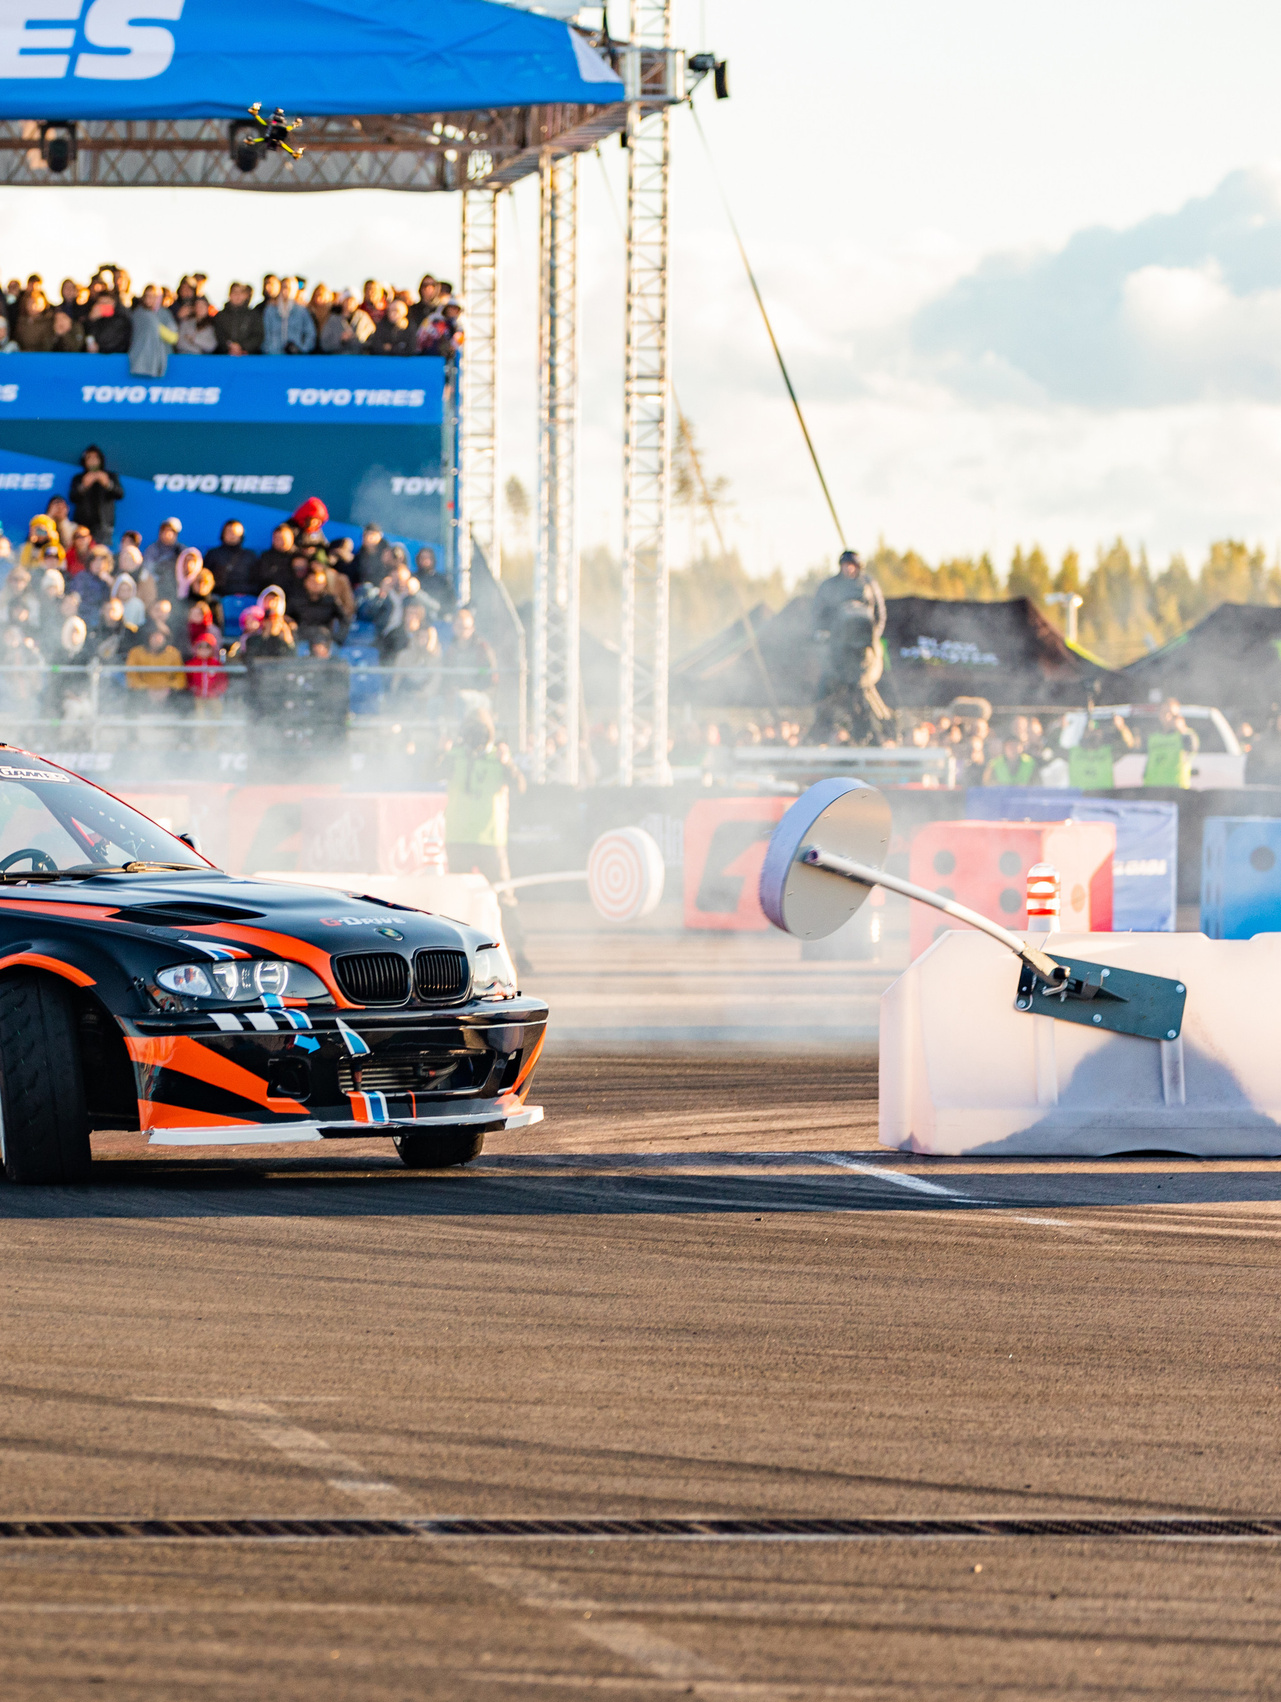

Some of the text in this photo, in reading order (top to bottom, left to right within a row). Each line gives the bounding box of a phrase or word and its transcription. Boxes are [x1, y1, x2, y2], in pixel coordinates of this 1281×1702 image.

[81, 385, 222, 404] TOYO TIRES
[286, 388, 426, 407] TOYO TIRES
[153, 474, 295, 494] TOYO TIRES
